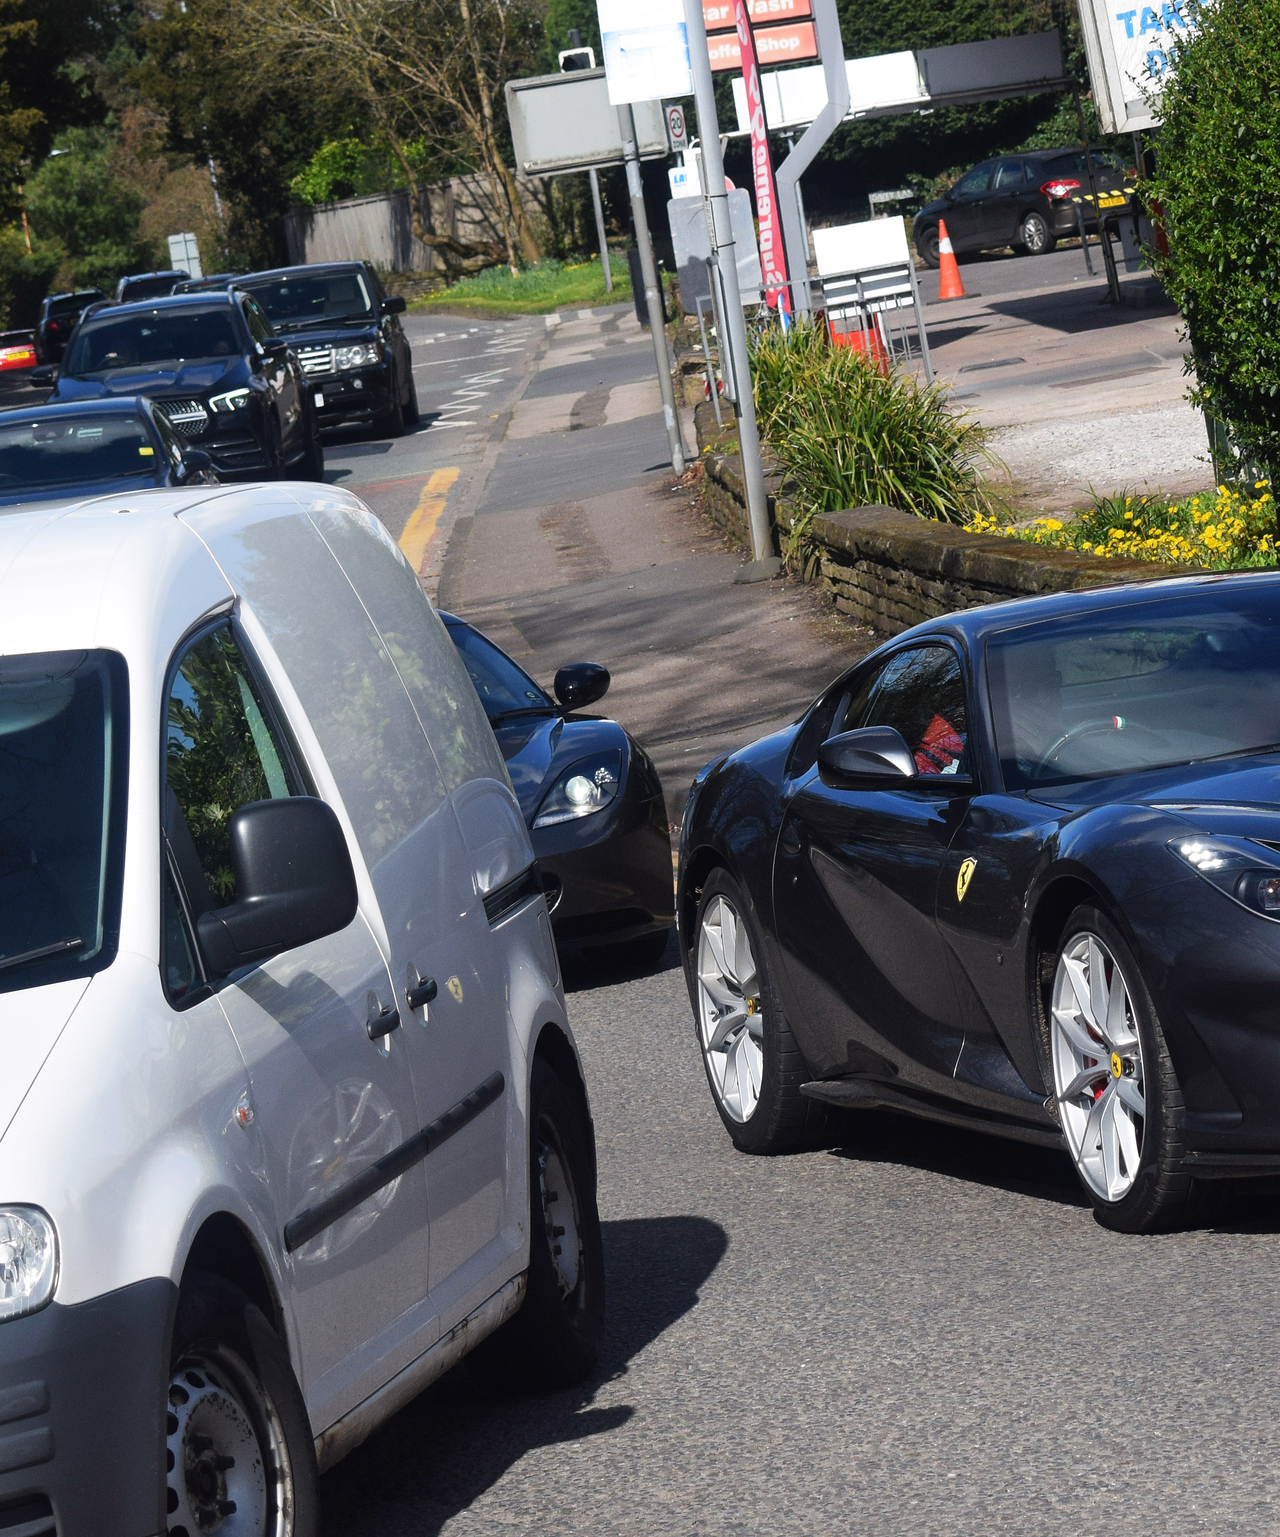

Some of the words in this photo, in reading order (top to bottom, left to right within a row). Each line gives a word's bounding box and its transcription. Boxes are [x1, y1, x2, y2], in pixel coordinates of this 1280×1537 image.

[703, 6, 729, 21] ar
[757, 37, 800, 53] Shop
[671, 117, 682, 129] 20
